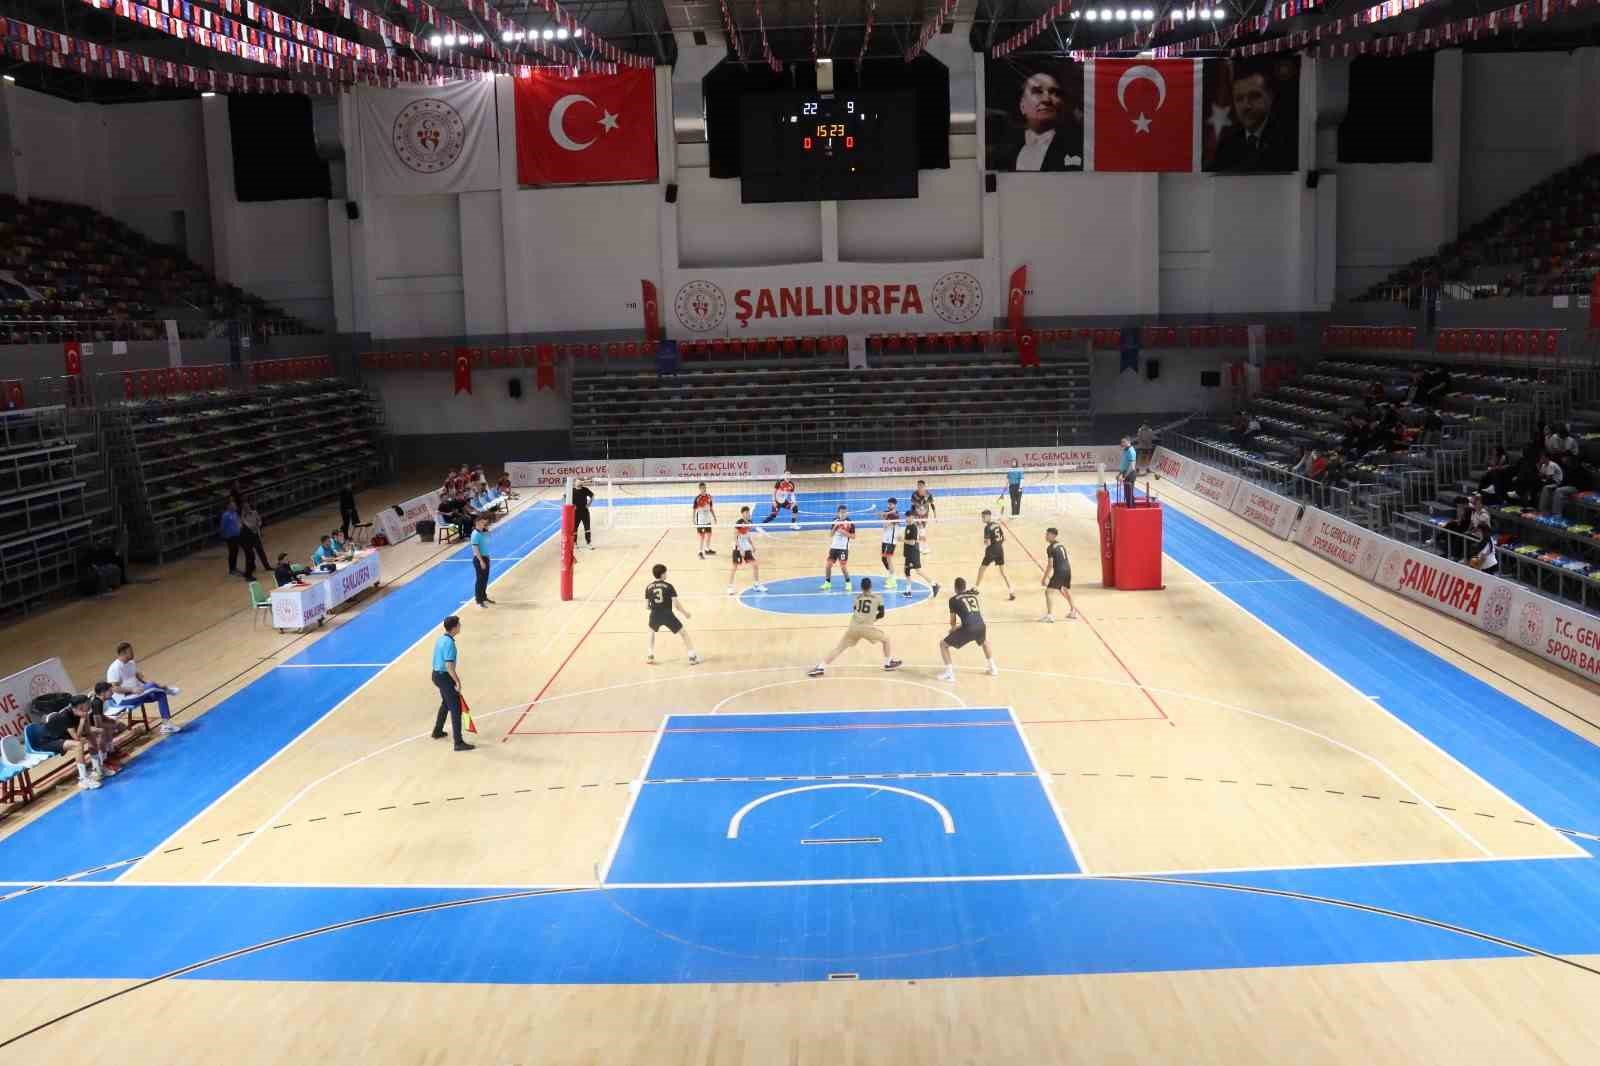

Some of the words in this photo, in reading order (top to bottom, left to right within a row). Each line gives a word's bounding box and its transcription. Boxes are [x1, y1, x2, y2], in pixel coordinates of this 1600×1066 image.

[804, 103, 817, 115] 22
[847, 101, 854, 113] 9
[817, 125, 827, 137] 15
[830, 124, 845, 137] 23
[804, 138, 811, 149] 0
[847, 137, 853, 147] 0
[734, 283, 922, 328] ŞANLIURFA
[737, 461, 750, 469] VE
[938, 455, 952, 463] VE
[595, 465, 608, 474] VE
[1399, 558, 1482, 615] ŞANLIURFA
[654, 588, 664, 603] 3
[856, 599, 872, 614] 16
[961, 597, 979, 613] 13
[1556, 616, 1573, 639] T.C.
[1546, 639, 1577, 664] SPOR
